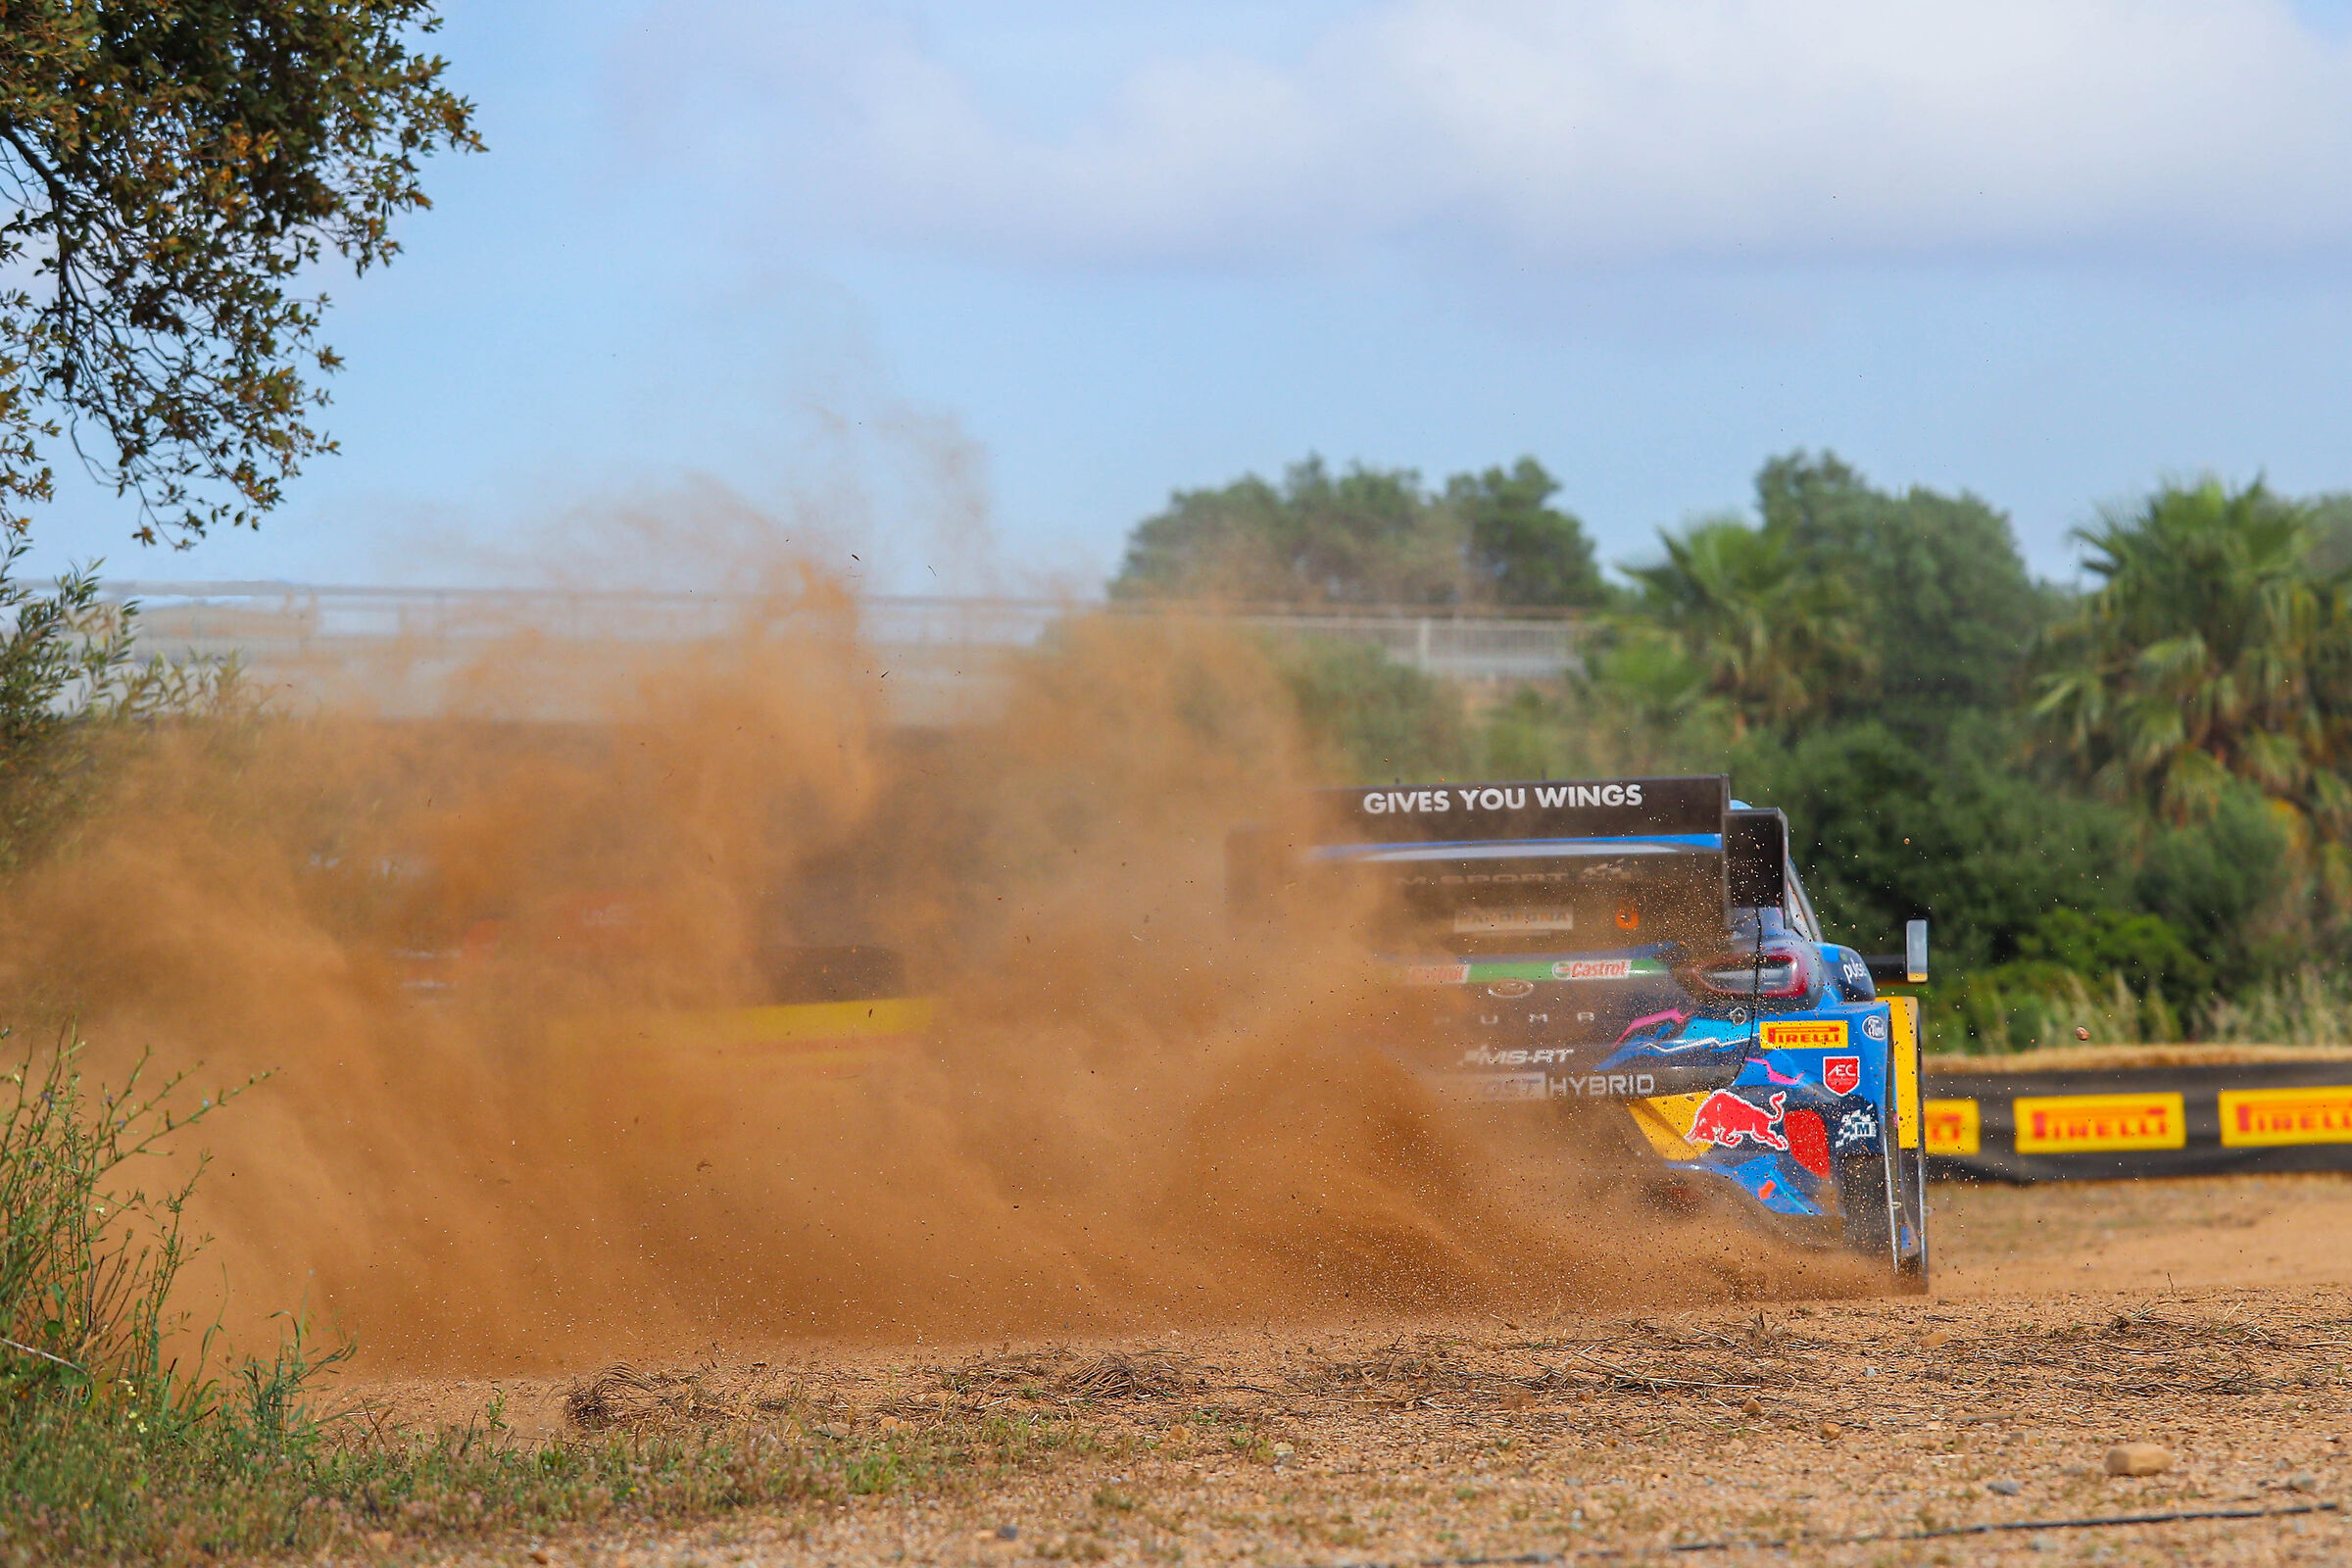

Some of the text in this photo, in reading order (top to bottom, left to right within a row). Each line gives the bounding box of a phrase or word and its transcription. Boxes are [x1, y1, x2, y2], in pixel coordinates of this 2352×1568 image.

[1363, 784, 1643, 813] GIVES YOU WINGS
[1571, 959, 1629, 978] Castrol
[1767, 1027, 1840, 1043] PIRELLI
[1549, 1074, 1655, 1097] HYBRID
[2033, 1106, 2167, 1140] PIRELLI
